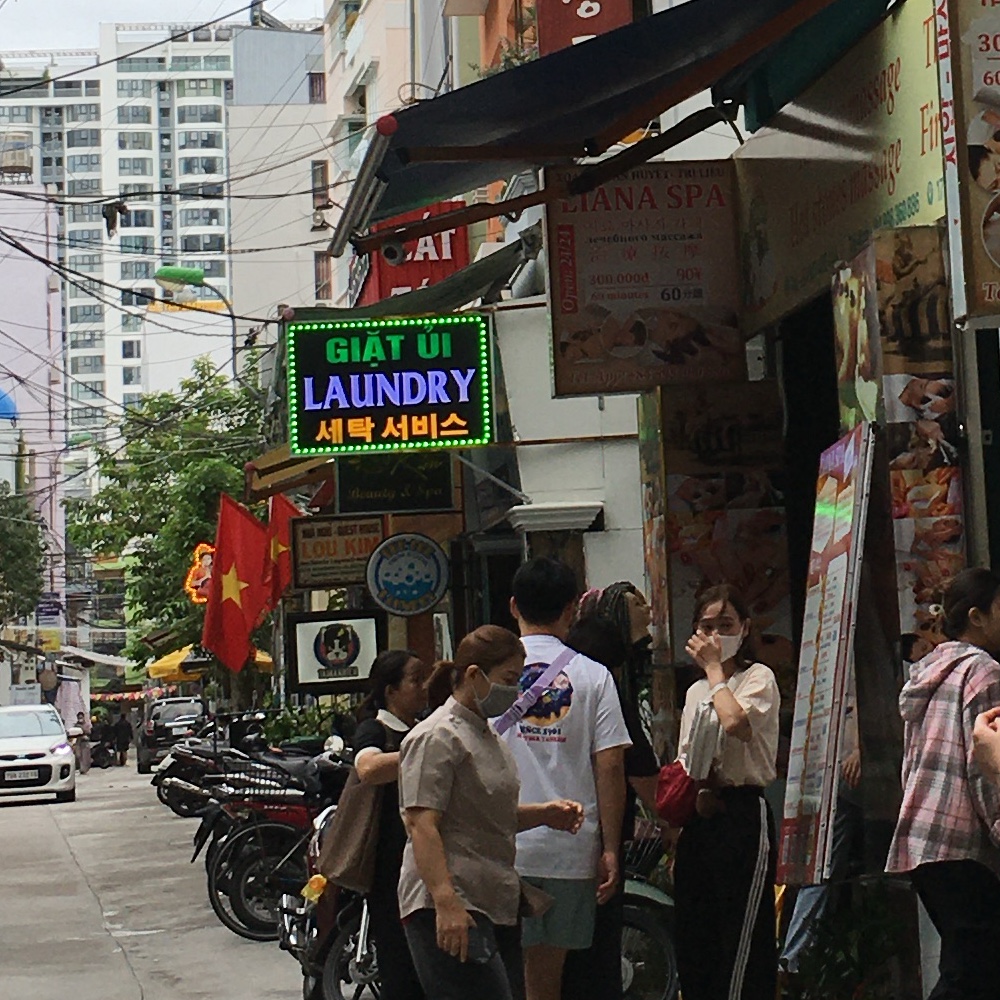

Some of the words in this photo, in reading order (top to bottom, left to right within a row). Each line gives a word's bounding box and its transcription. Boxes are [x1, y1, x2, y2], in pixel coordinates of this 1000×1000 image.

[666, 183, 726, 209] SPA
[325, 330, 405, 368] GIẶT
[417, 325, 452, 359] ỦI
[303, 368, 476, 411] LAUNDRY
[315, 416, 375, 444] 세탁
[381, 412, 469, 441] 서비스
